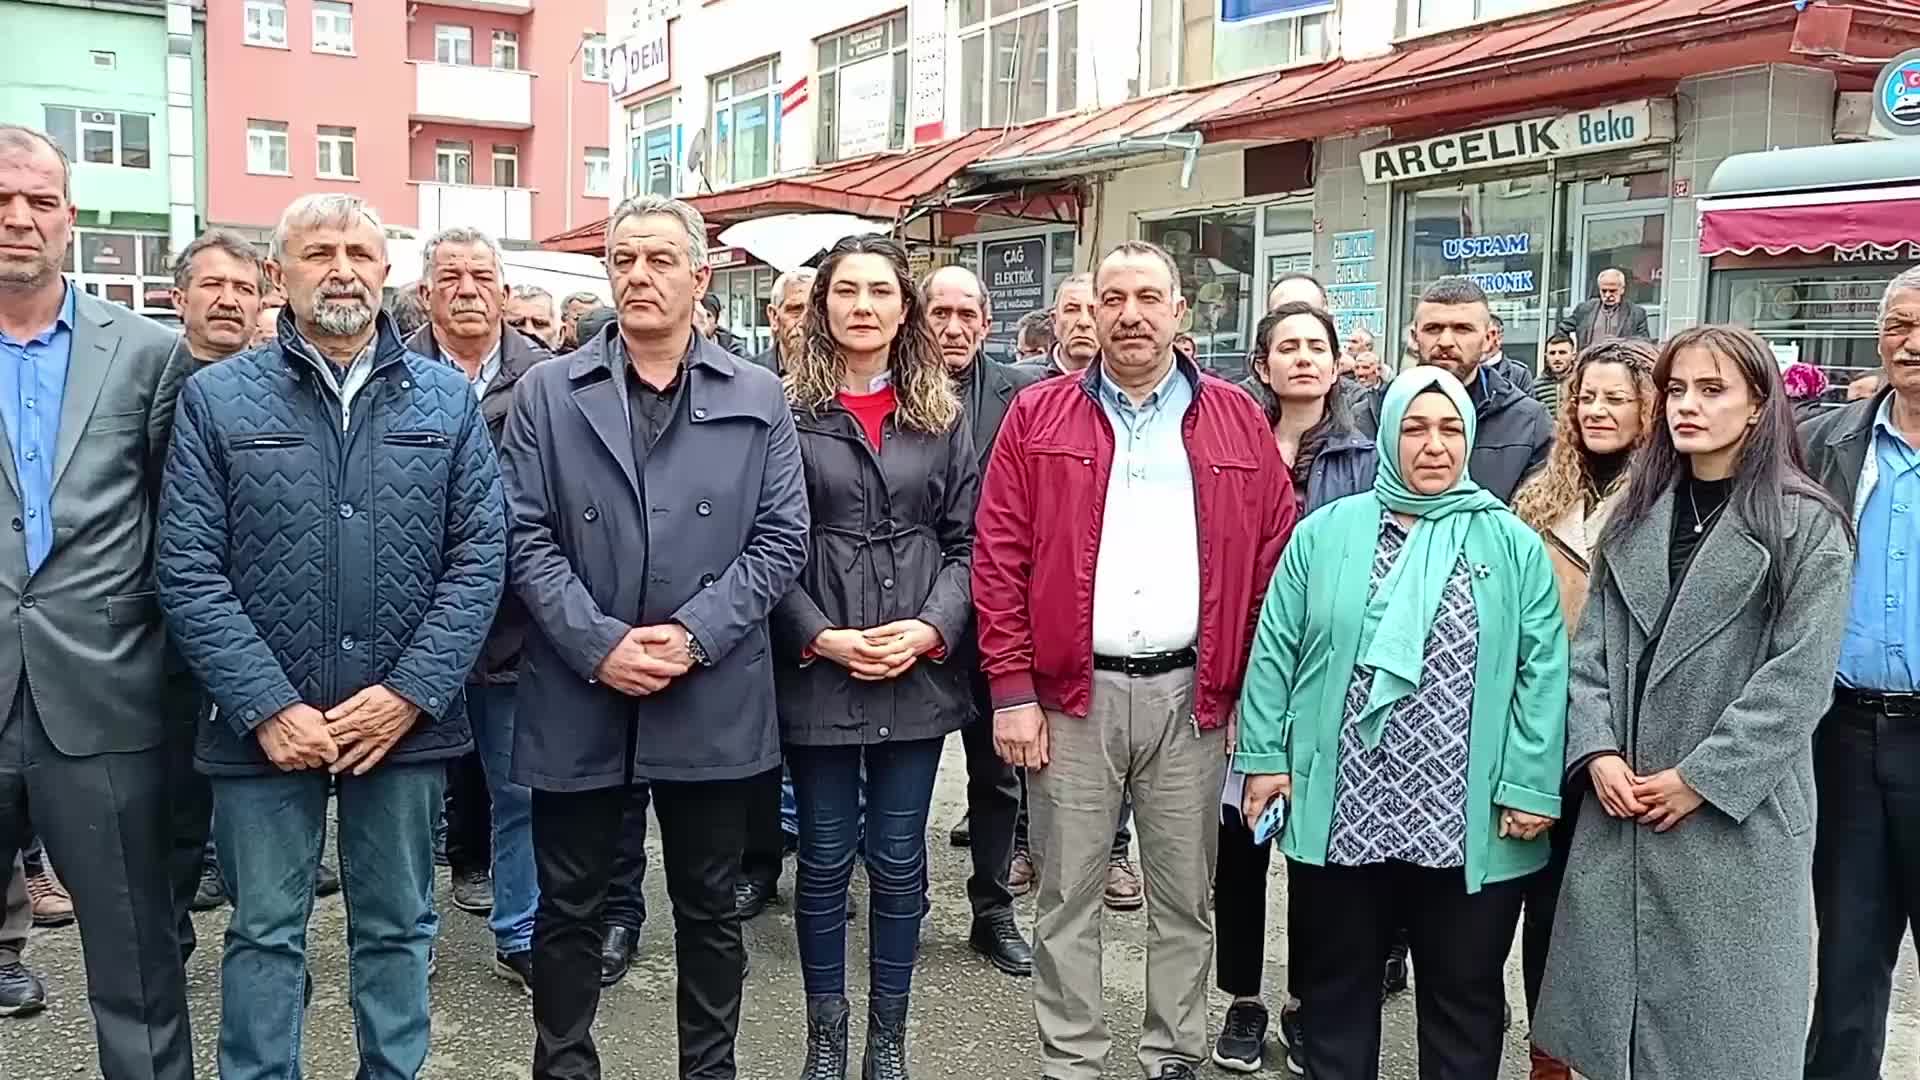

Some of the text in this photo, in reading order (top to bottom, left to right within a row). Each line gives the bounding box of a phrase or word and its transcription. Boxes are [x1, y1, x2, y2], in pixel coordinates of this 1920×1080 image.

[631, 37, 664, 75] DEM
[1374, 109, 1635, 180] ARÇELİK Beko
[1003, 245, 1025, 268] ÇAĞ
[1442, 233, 1529, 260] USTAM
[994, 266, 1034, 286] ELEKTRİK
